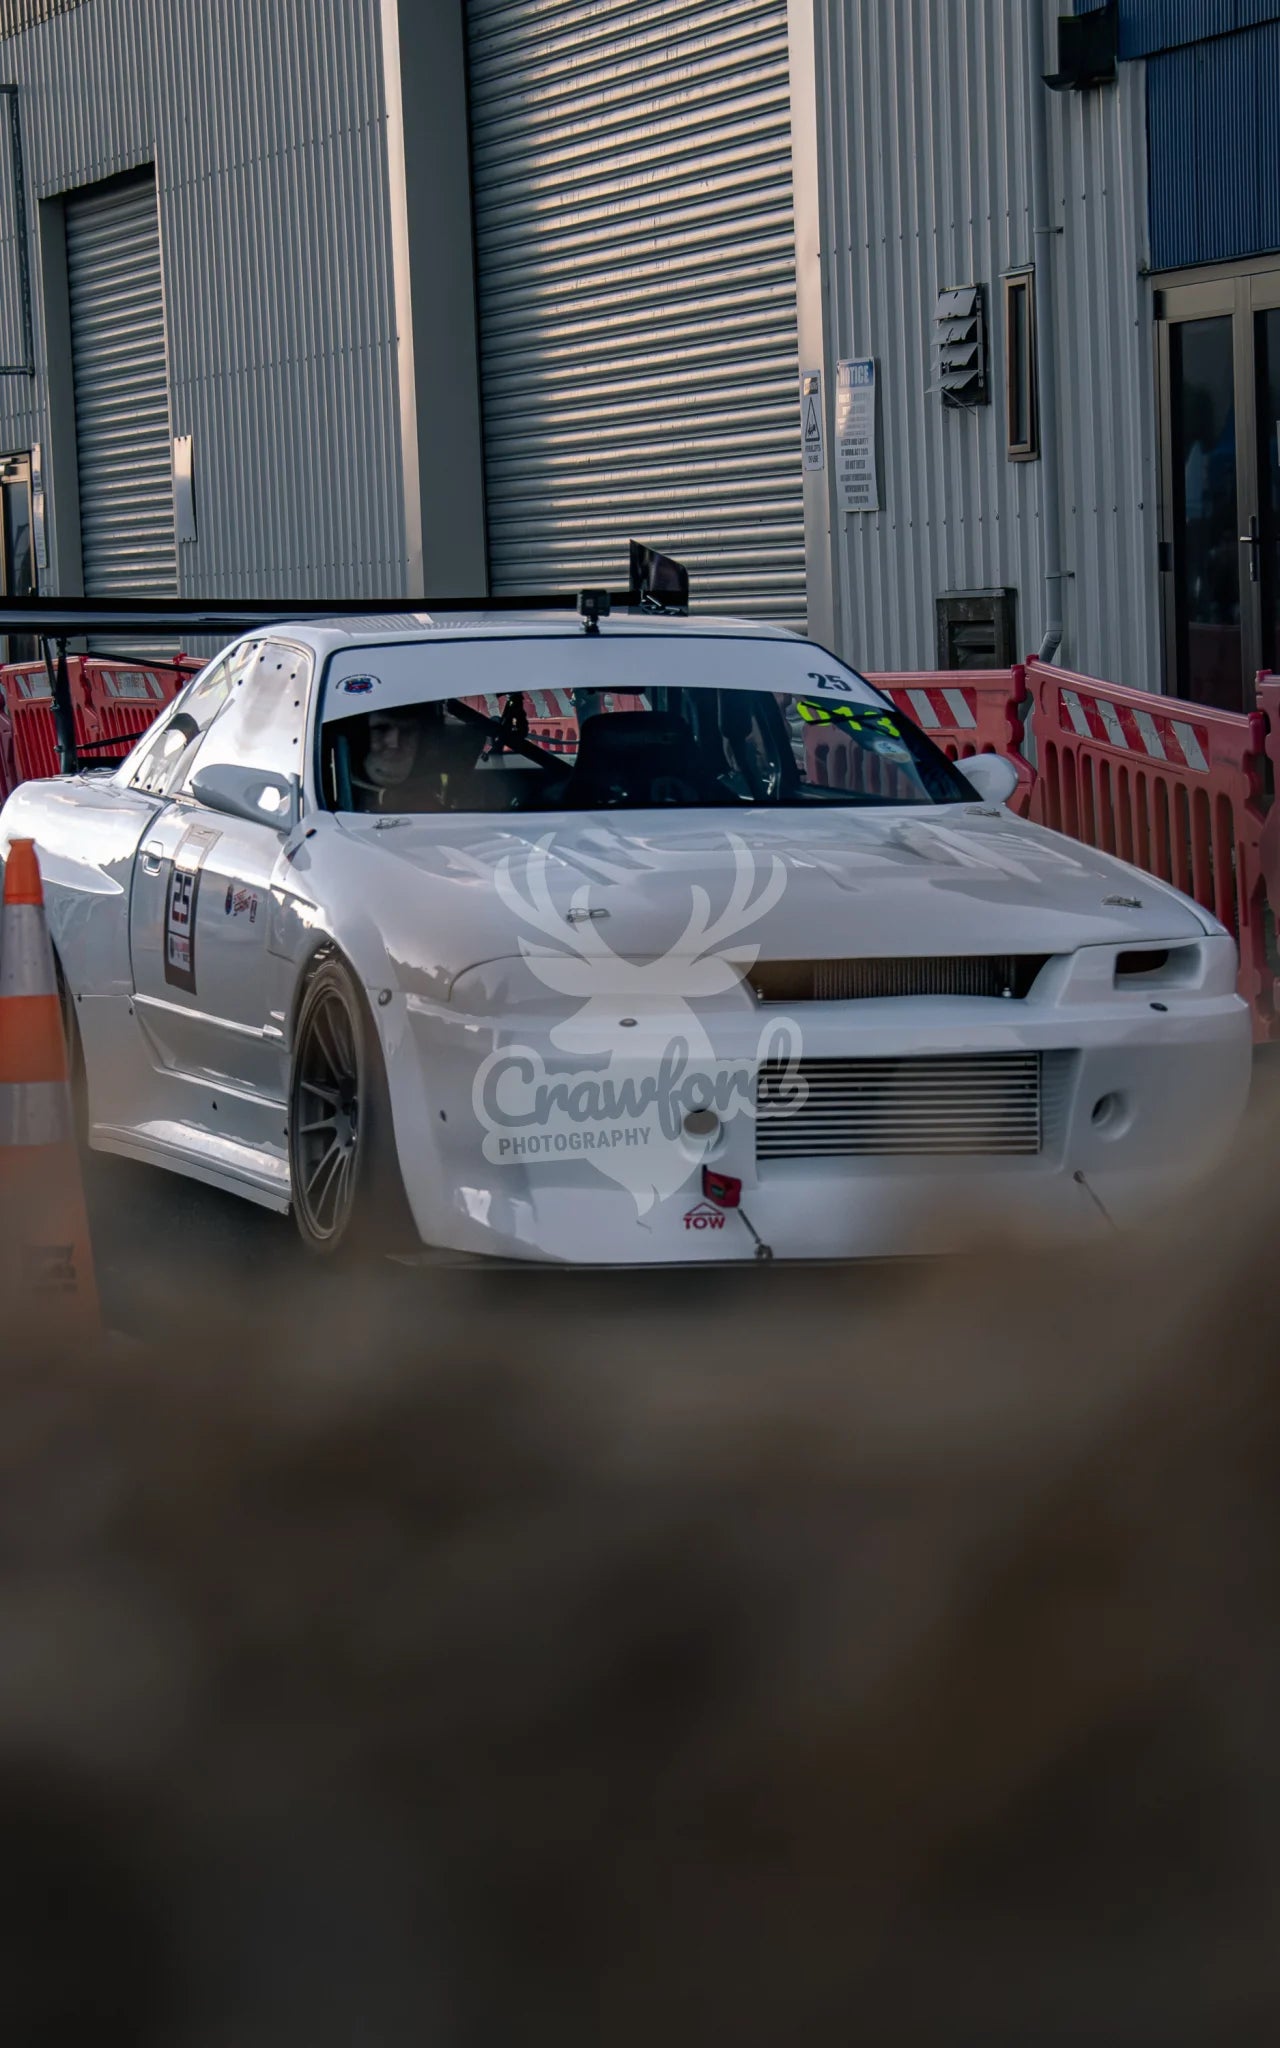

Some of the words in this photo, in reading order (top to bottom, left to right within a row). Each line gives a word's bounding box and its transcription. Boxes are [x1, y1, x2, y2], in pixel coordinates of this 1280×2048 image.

[840, 364, 870, 386] NOTICE
[807, 672, 853, 692] 25
[683, 1215, 725, 1230] TOW
